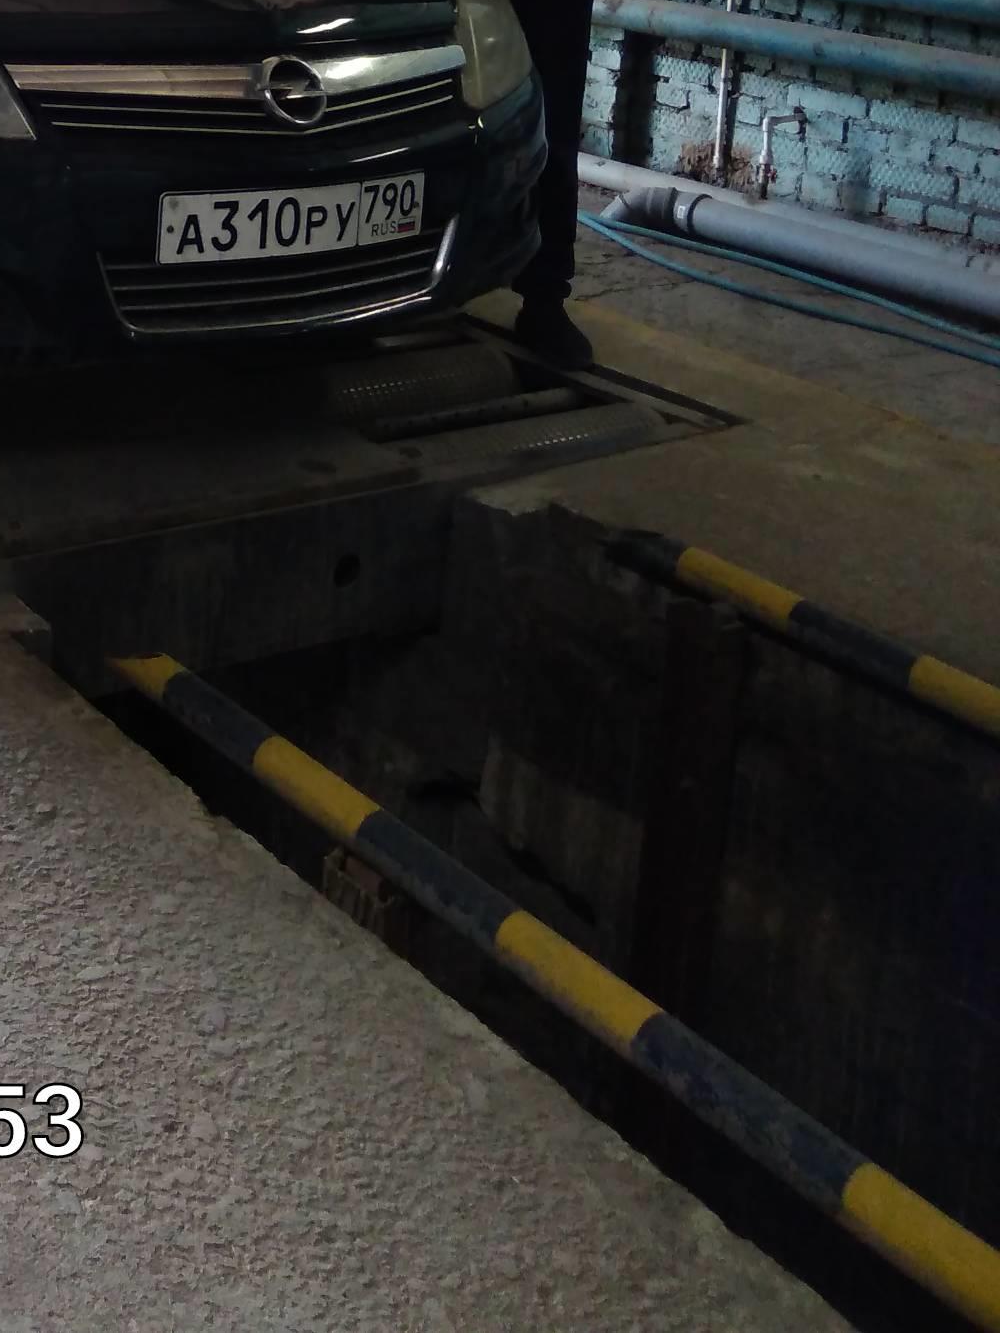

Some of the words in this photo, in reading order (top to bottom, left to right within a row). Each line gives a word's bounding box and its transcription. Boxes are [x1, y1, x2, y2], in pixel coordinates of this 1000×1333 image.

[176, 197, 356, 255] А310РУ
[364, 179, 415, 223] 790
[371, 222, 397, 237] RUS
